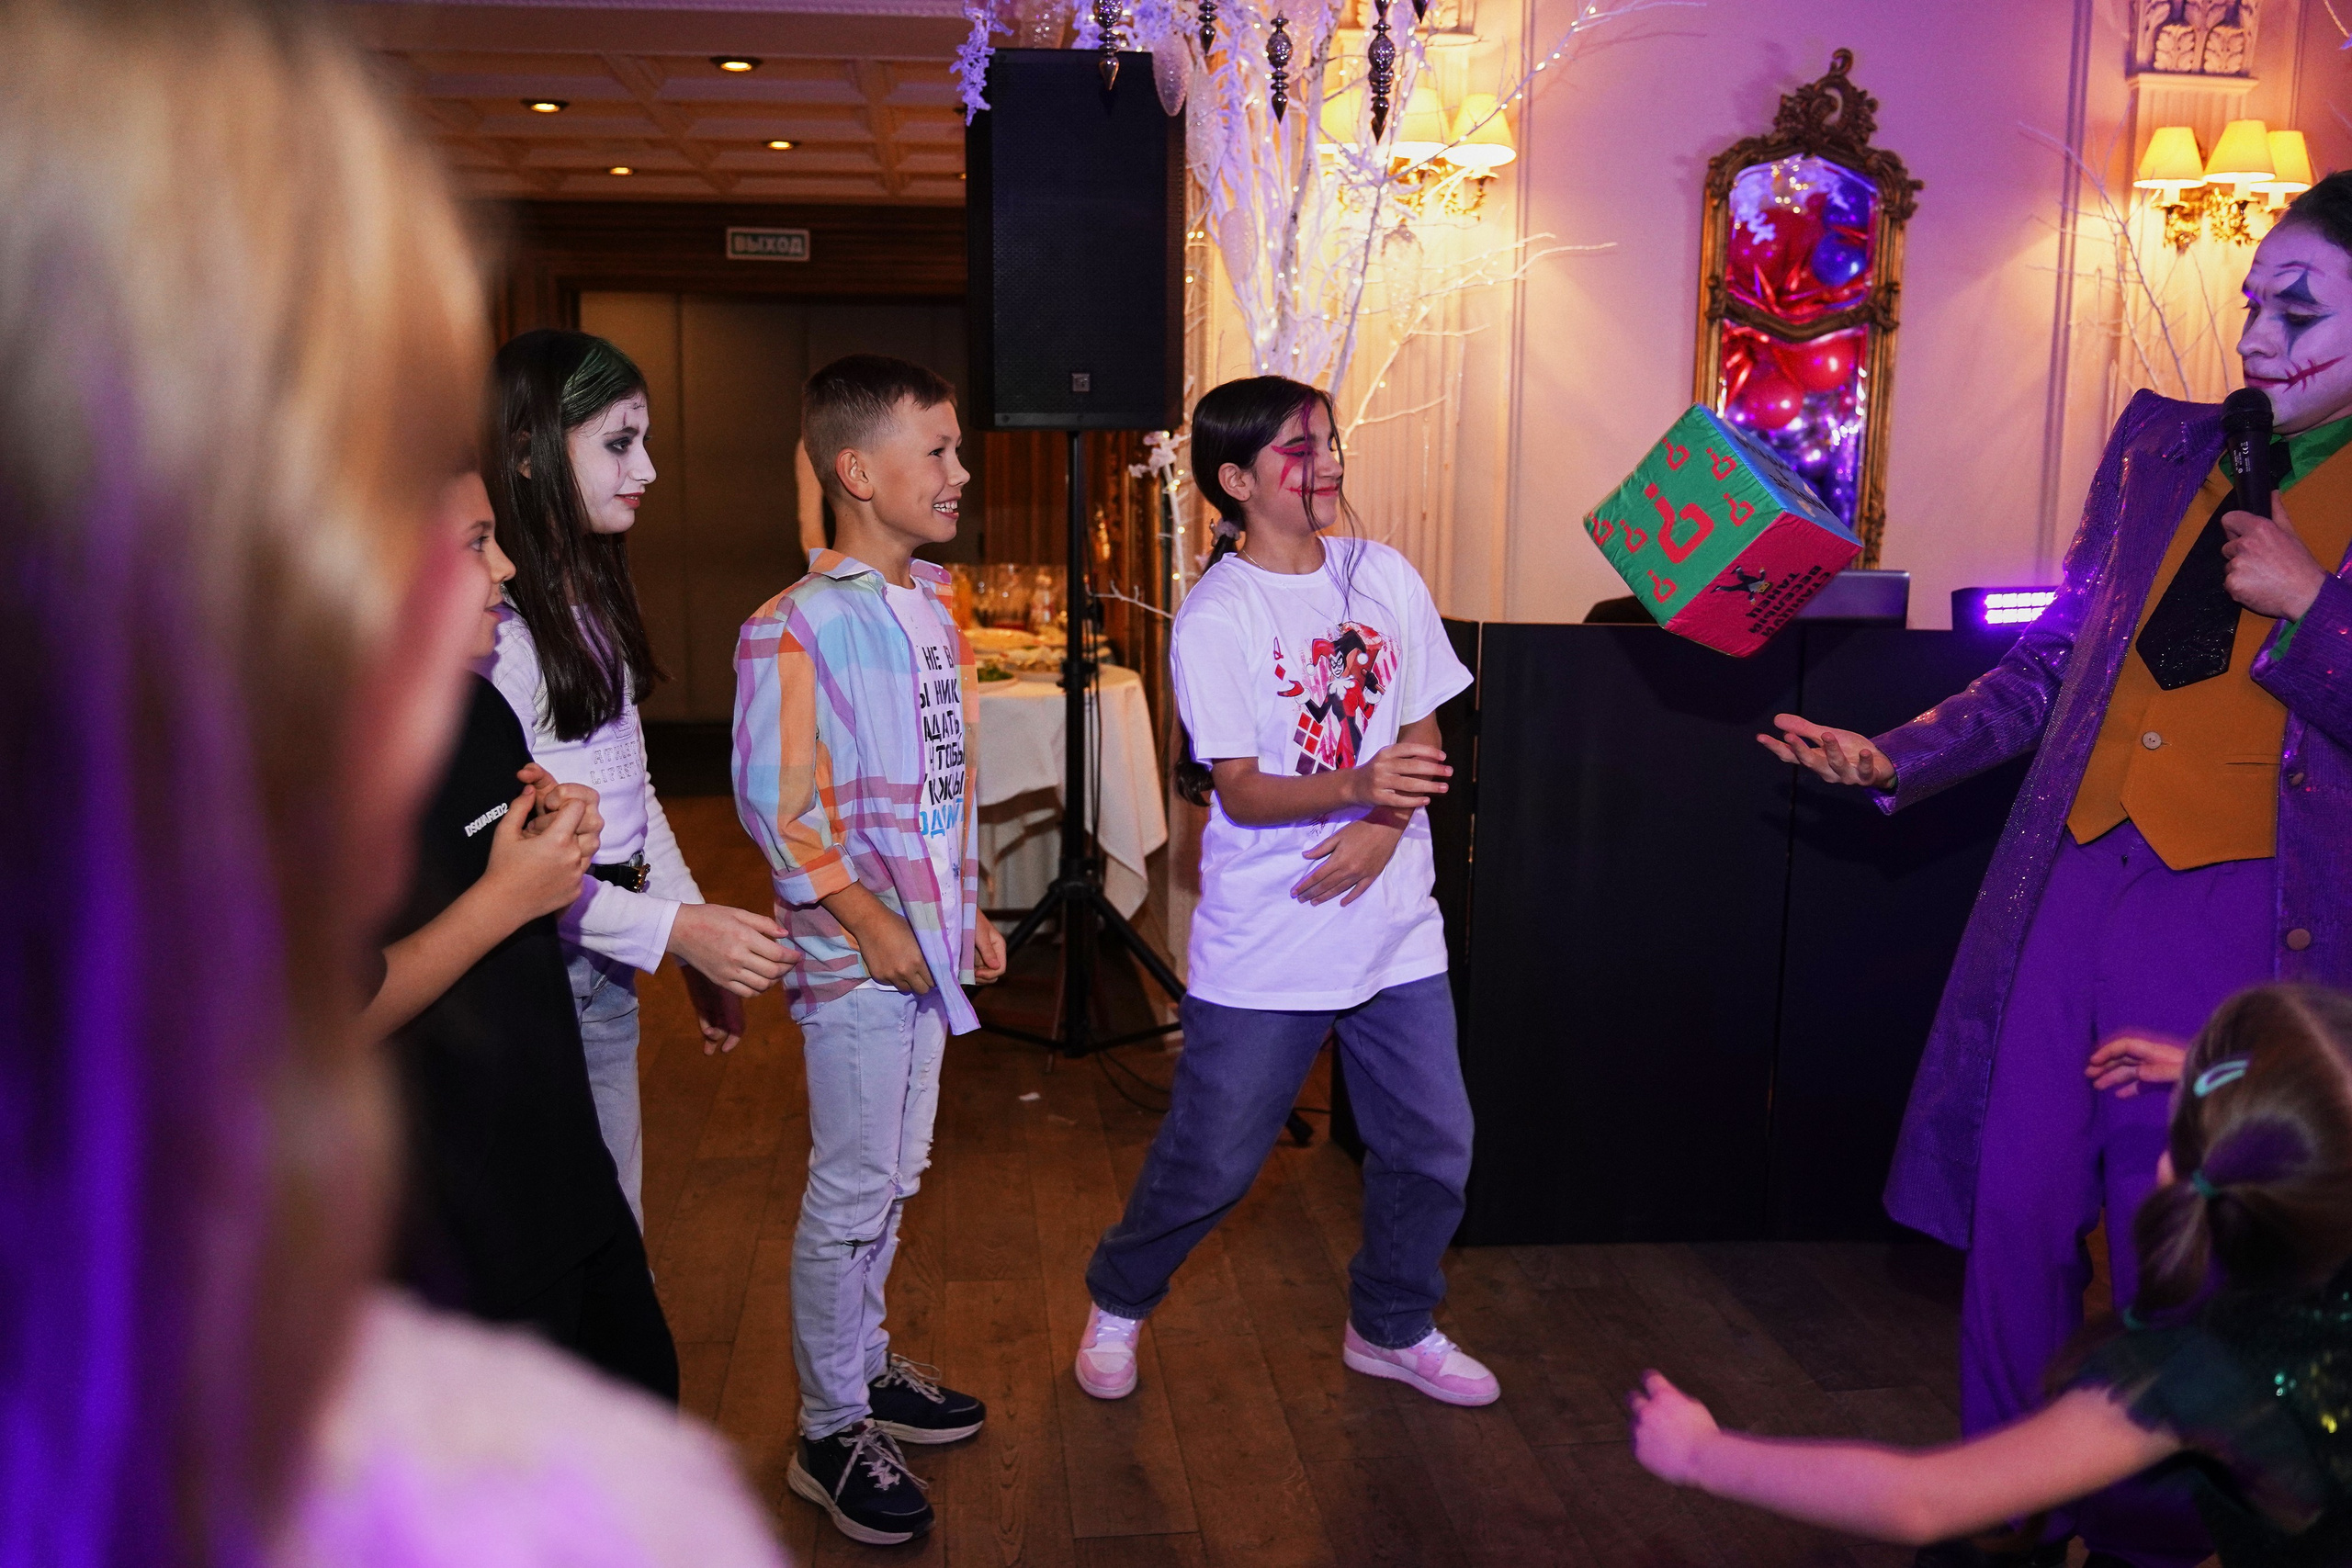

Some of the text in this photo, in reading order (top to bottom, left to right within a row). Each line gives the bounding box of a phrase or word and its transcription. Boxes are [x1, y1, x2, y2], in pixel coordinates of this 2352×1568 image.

[734, 234, 804, 254] ВЫХОД
[1746, 572, 1800, 619] ТАНЕЦ
[1748, 565, 1823, 634] ВЕСЕЛЫЙ
[1760, 571, 1832, 637] СТАНЦУЙ
[922, 646, 943, 671] НЕ
[934, 678, 960, 705] НИК
[594, 739, 639, 765] ATHLET
[464, 802, 510, 838] DSQUARED2
